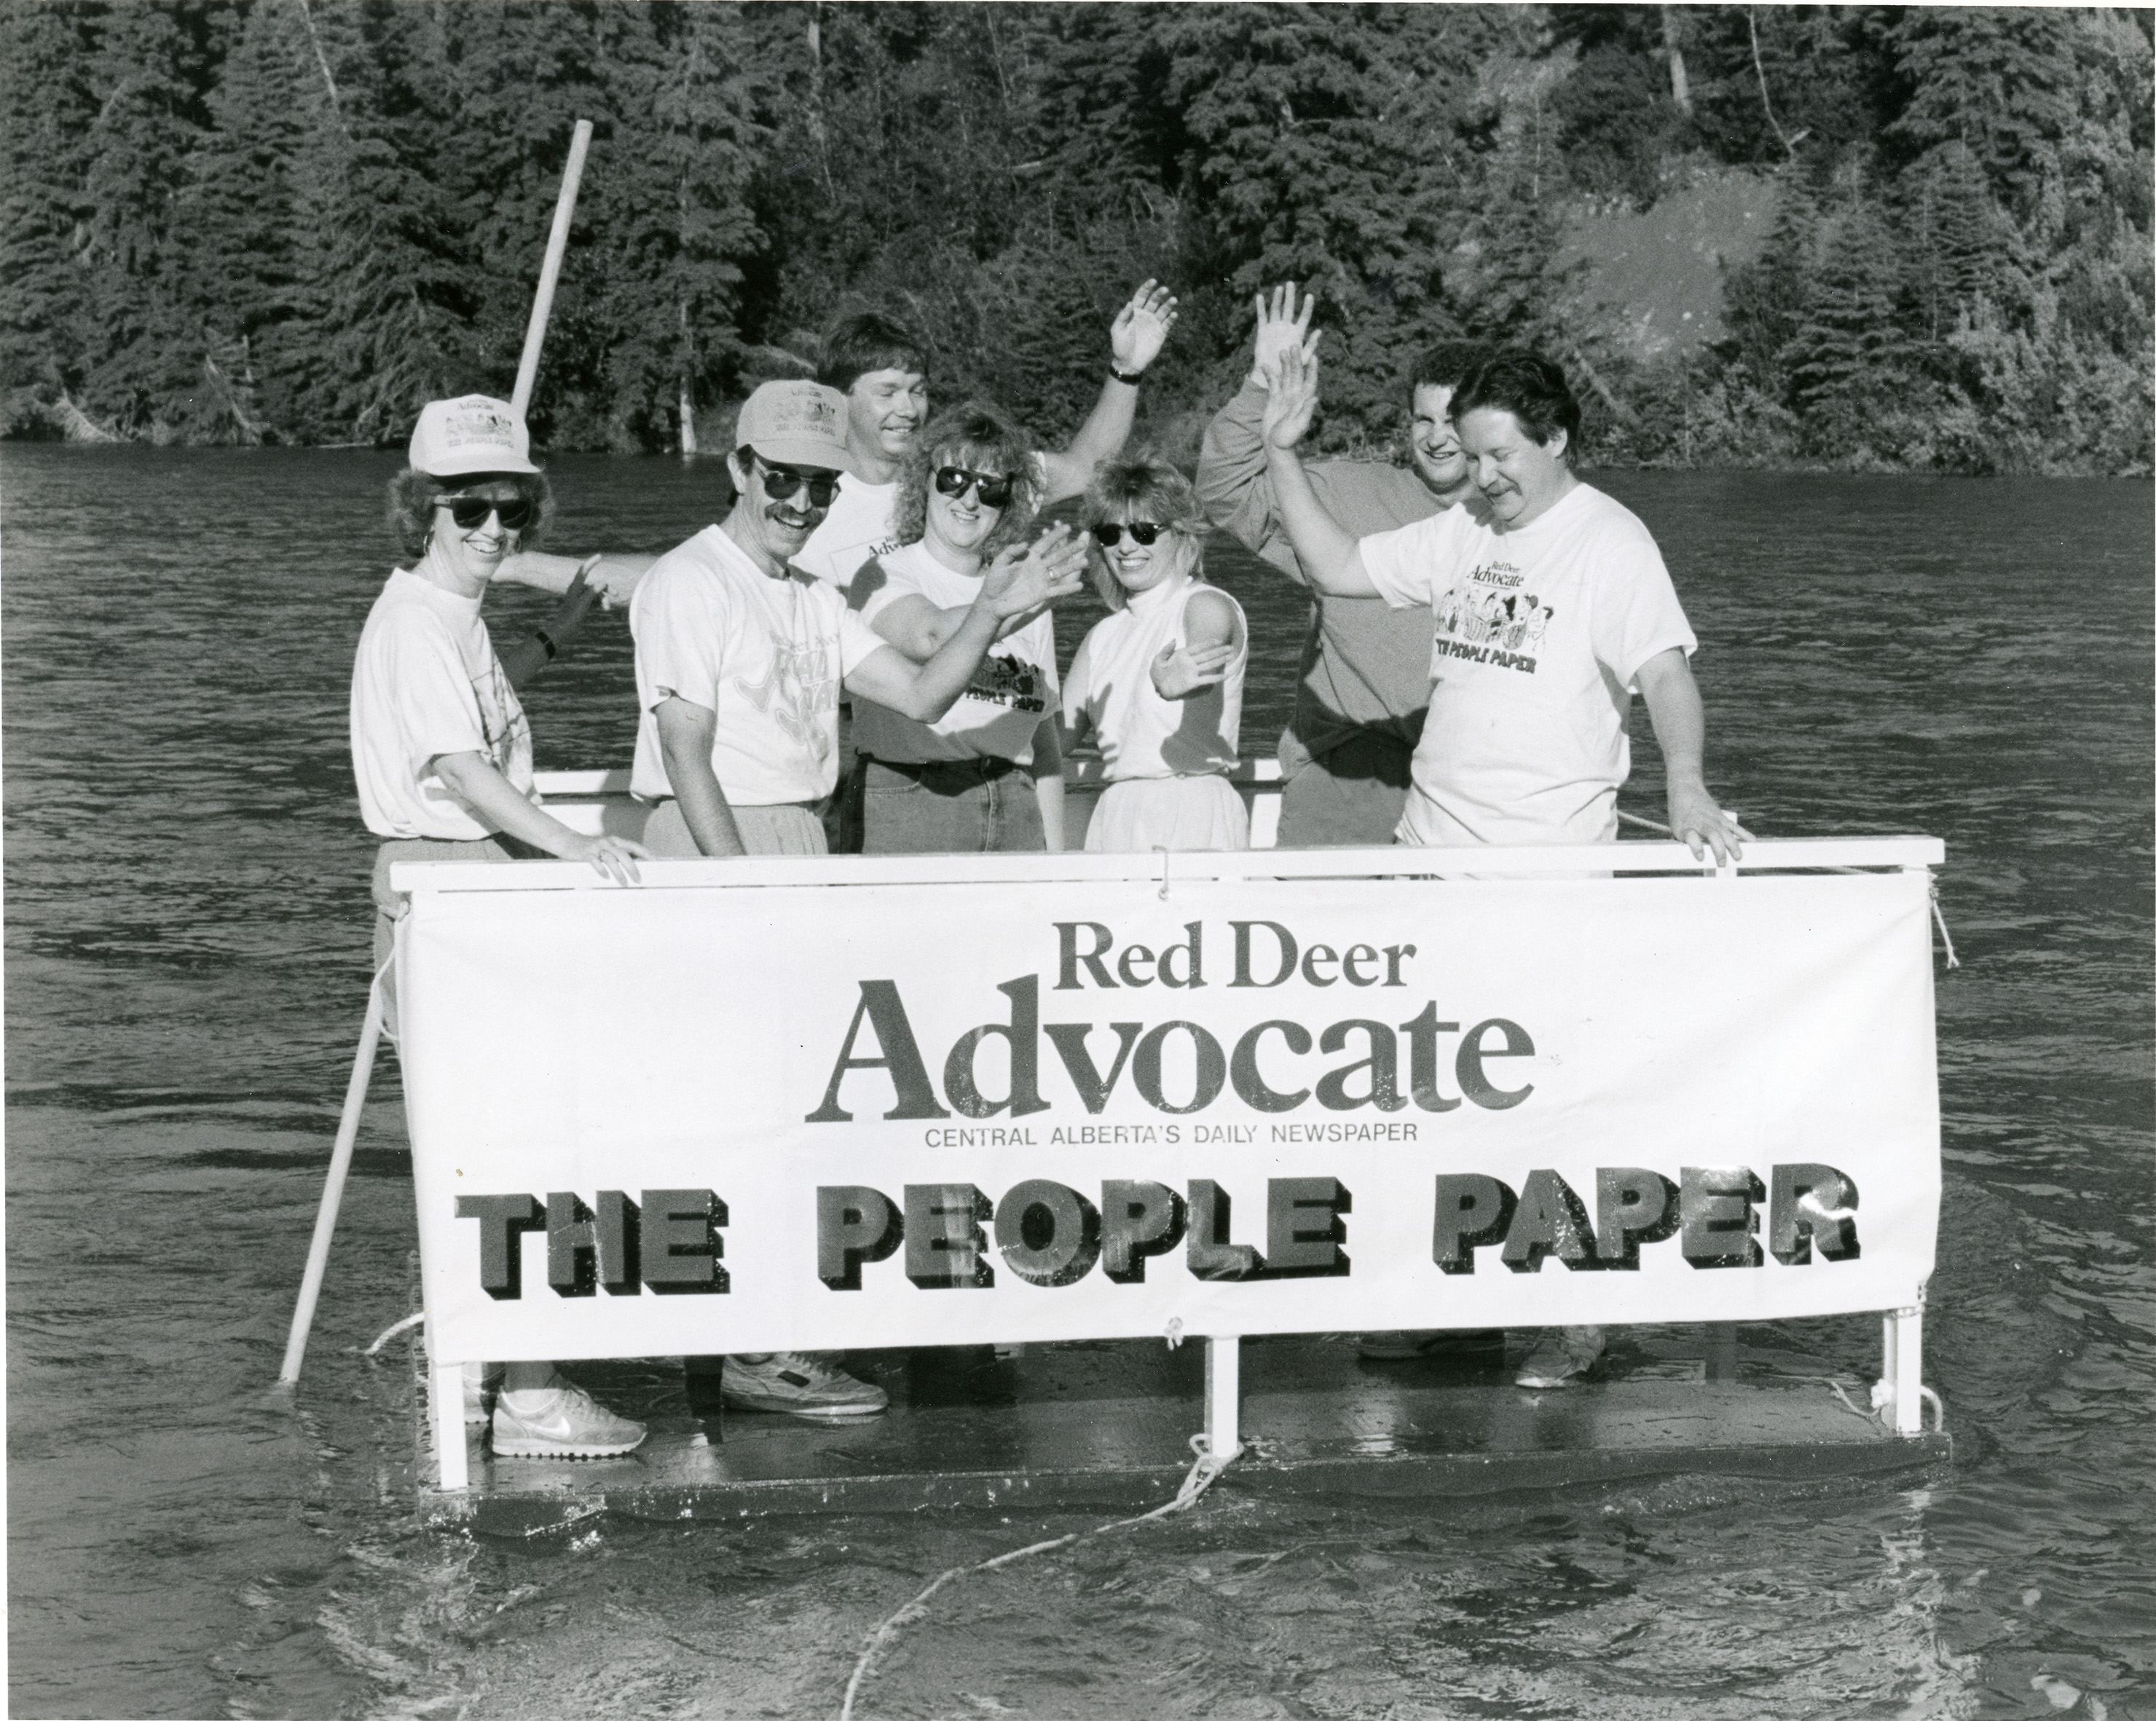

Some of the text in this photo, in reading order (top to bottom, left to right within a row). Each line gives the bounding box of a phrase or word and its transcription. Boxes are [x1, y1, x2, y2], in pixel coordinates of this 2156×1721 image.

[1466, 564, 1524, 587] Advocate
[1491, 561, 1504, 570] Red
[1490, 649, 1537, 674] PAPER
[1052, 920, 1417, 990] Red Deer
[804, 973, 1536, 1123] Advocate
[924, 1122, 1418, 1149] CENTRAL ALBERTA'S DAILY NEWSPAPER
[455, 1162, 1862, 1301] THE PEOPLE PAPER
